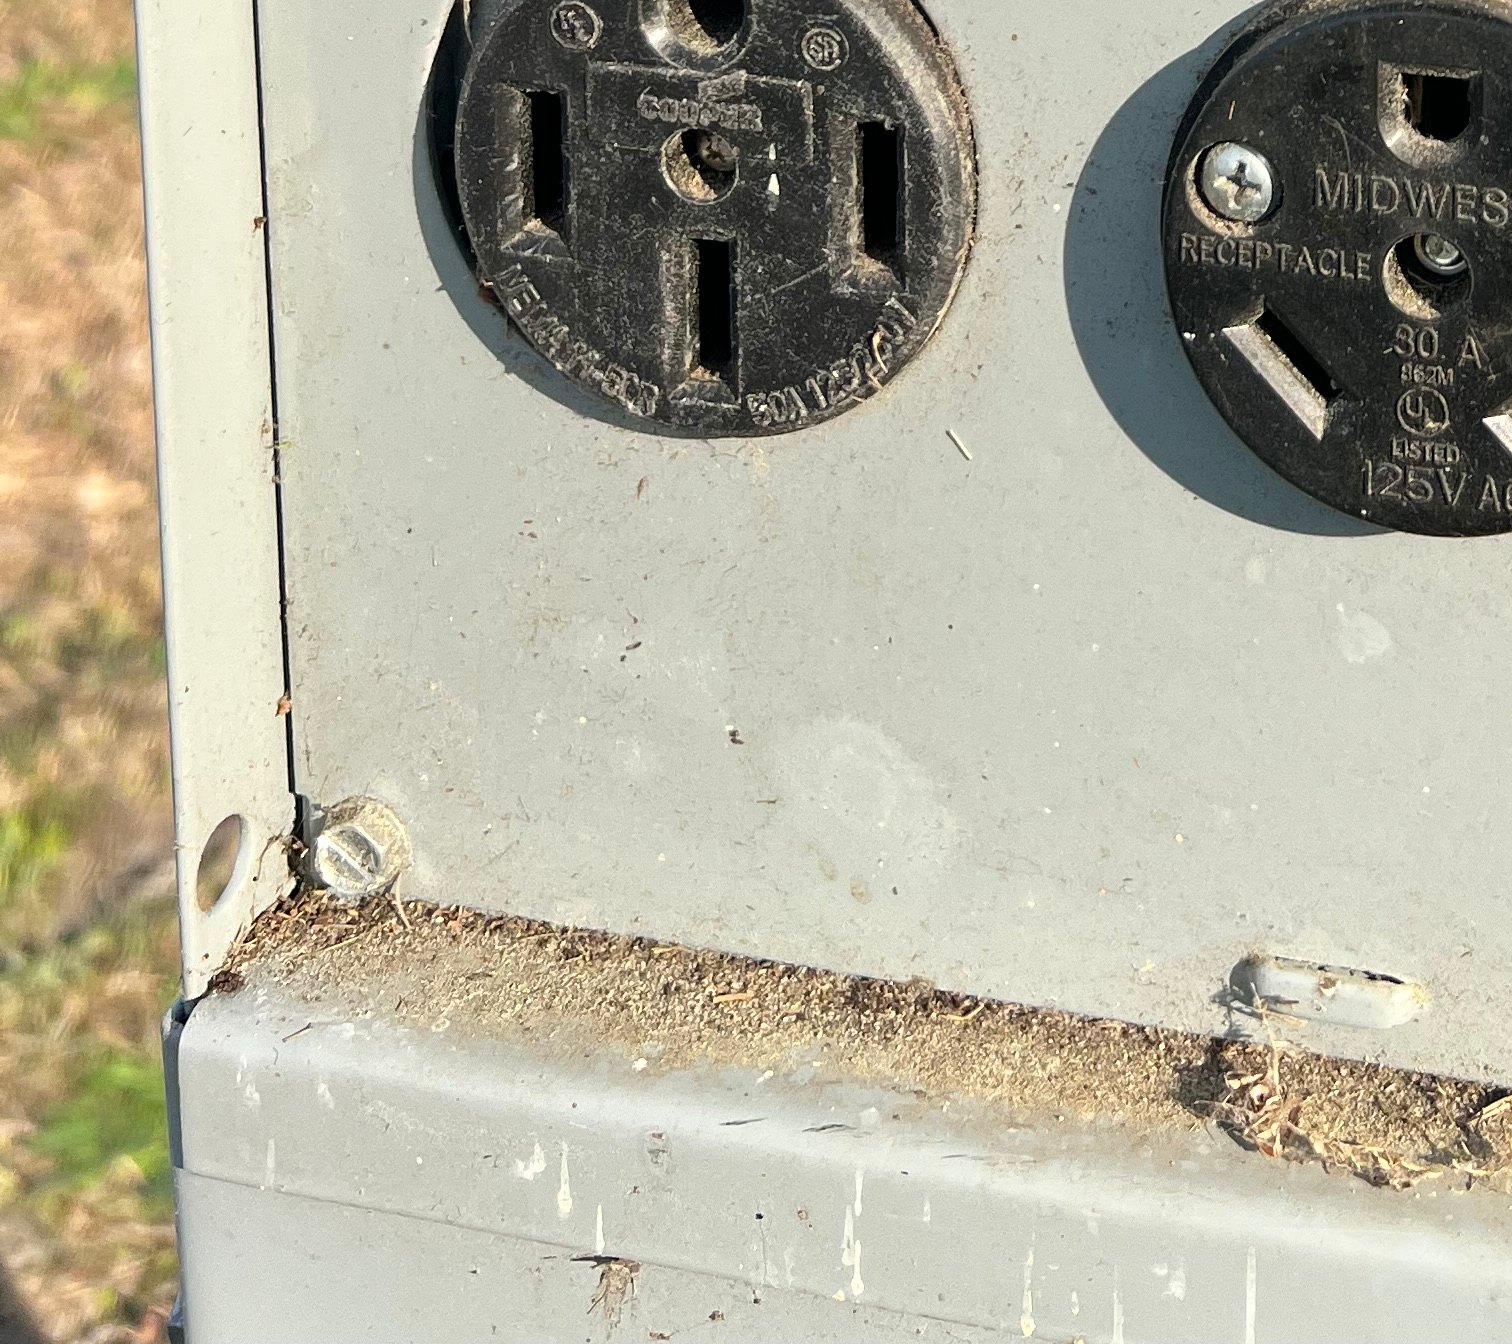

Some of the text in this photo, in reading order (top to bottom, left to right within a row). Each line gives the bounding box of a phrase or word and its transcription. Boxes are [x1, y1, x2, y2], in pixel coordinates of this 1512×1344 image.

[1179, 233, 1372, 279] RECEPTACLE
[1393, 325, 1487, 370] 30 A
[1392, 439, 1460, 464] LISTED
[1360, 459, 1466, 505] 125V
